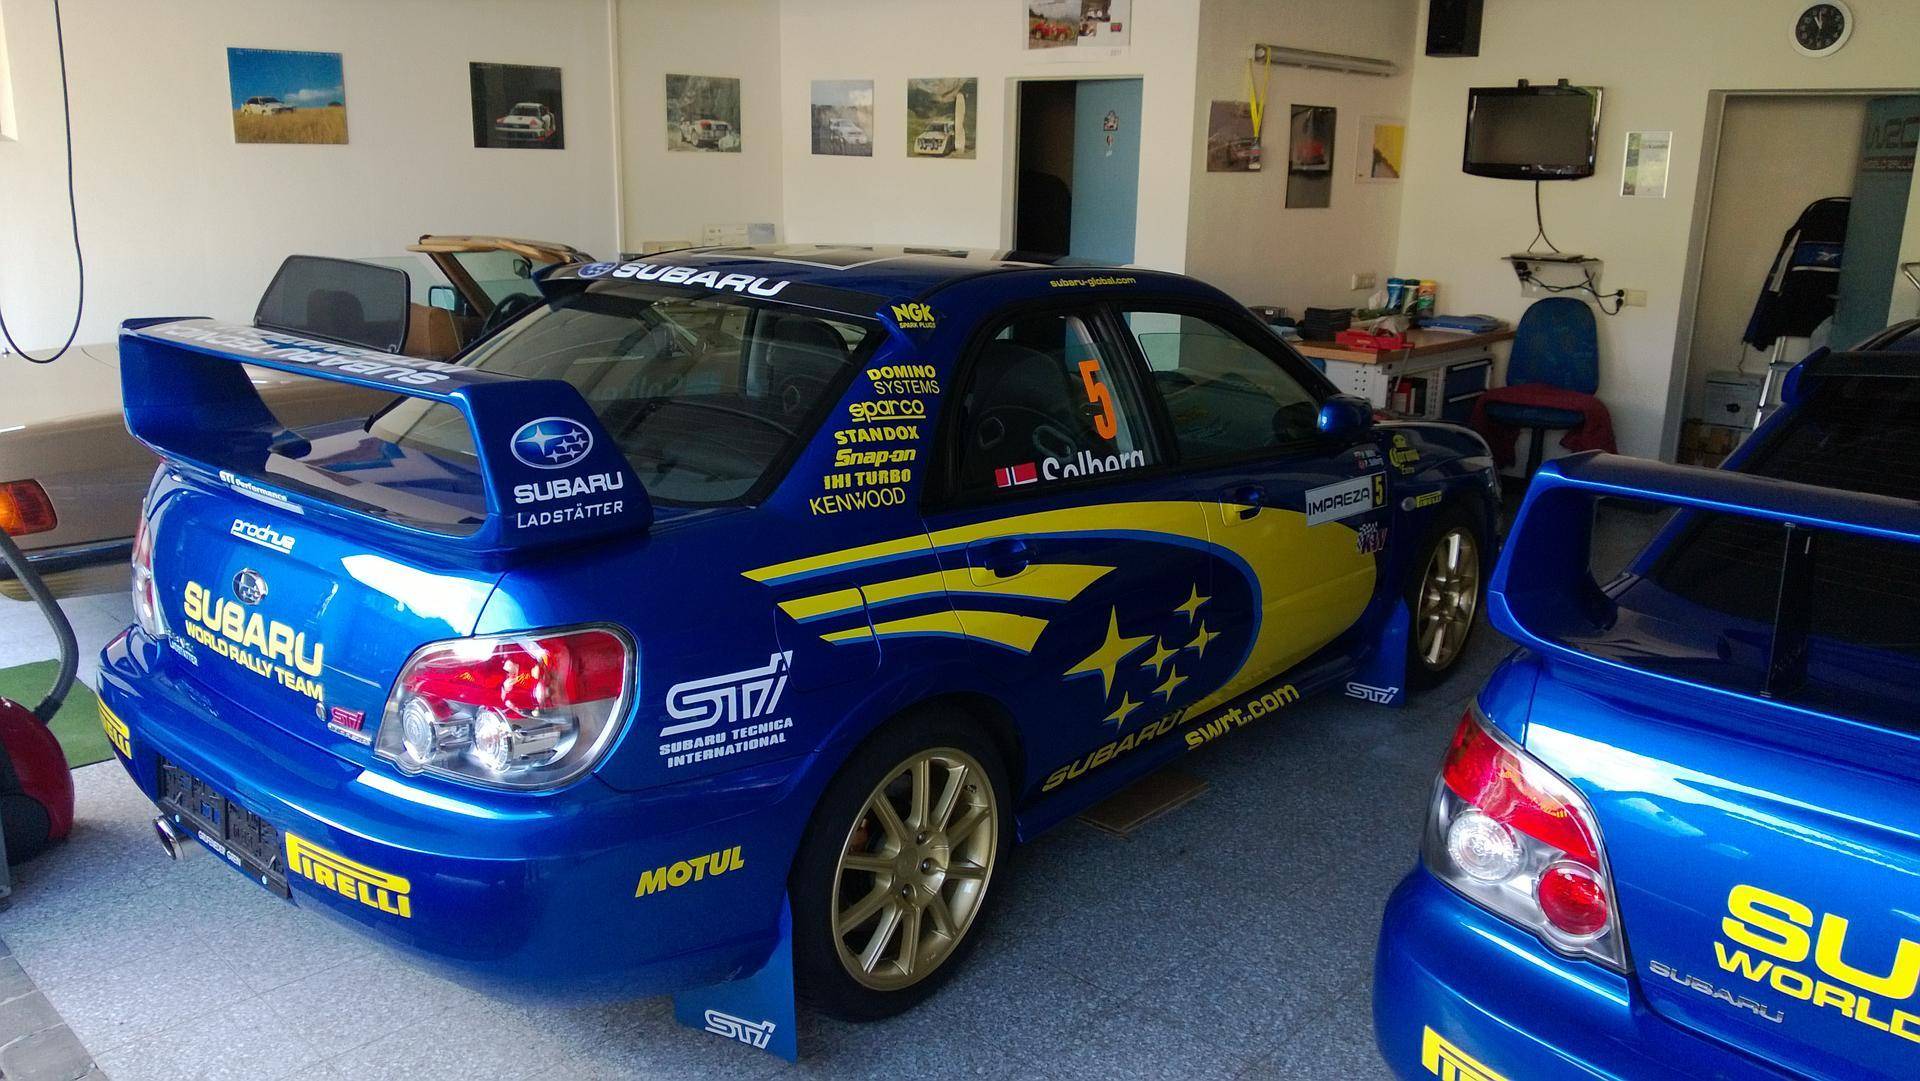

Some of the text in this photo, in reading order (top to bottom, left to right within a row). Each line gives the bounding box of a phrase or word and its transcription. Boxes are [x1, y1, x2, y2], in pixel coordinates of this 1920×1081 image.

[613, 262, 790, 297] SUBARU
[1050, 276, 1136, 287] subaru-global.com
[891, 303, 936, 323] NGK
[918, 321, 936, 329] PLUGS
[866, 365, 936, 382] DOMINO
[874, 380, 940, 395] SYSTEMS
[849, 399, 926, 423] sparco
[1078, 359, 1118, 440] 5
[834, 425, 920, 445] STANDOX
[834, 448, 917, 468] Snap-on
[514, 471, 624, 504] SUBARU
[824, 469, 911, 490] IHI TURBO
[1308, 475, 1384, 516] IMPREZA 5
[517, 501, 624, 529] LADSTÄTTER
[809, 487, 906, 516] KENWOOD
[184, 581, 324, 676] SUBARU
[185, 620, 230, 662] WORLD
[229, 644, 273, 680] RALLY
[275, 664, 323, 702] TEAM
[1184, 683, 1300, 751] swrt.com
[659, 717, 794, 756] SUBARU TECNICA
[667, 732, 787, 768] INTERNATIONAL
[1041, 707, 1185, 793] SUBARU
[285, 831, 412, 918] PIRELLI
[634, 845, 745, 898] MOTUL
[1649, 960, 1785, 1024] SUBARU
